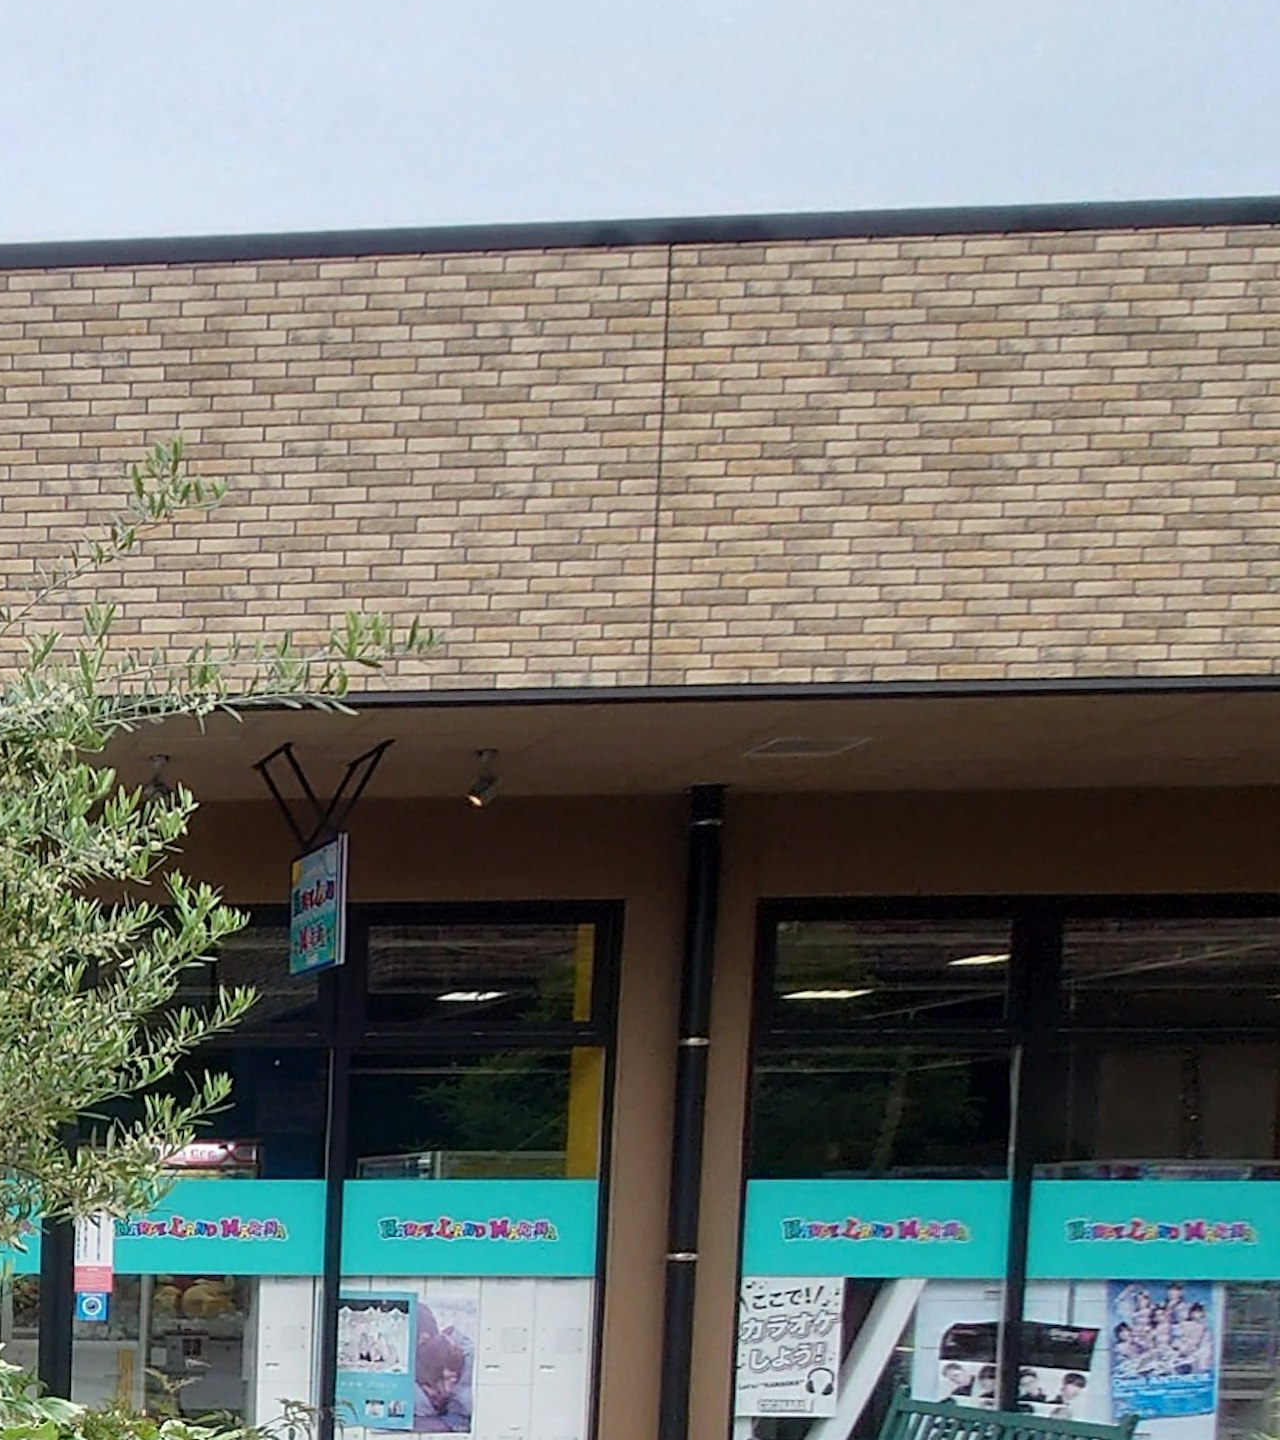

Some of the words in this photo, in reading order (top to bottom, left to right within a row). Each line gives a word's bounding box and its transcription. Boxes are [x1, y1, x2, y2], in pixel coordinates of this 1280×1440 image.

[169, 1216, 217, 1238] LAND
[220, 1217, 287, 1239] MARINA
[379, 1218, 434, 1239] HAPPY
[436, 1217, 486, 1240] LAND
[490, 1219, 557, 1241] MARINA
[782, 1219, 839, 1240] HAPPY
[841, 1217, 894, 1241] LAND
[1128, 1219, 1180, 1242] LAND
[740, 1310, 839, 1343] カラオケ
[749, 1342, 827, 1373] しよう!
